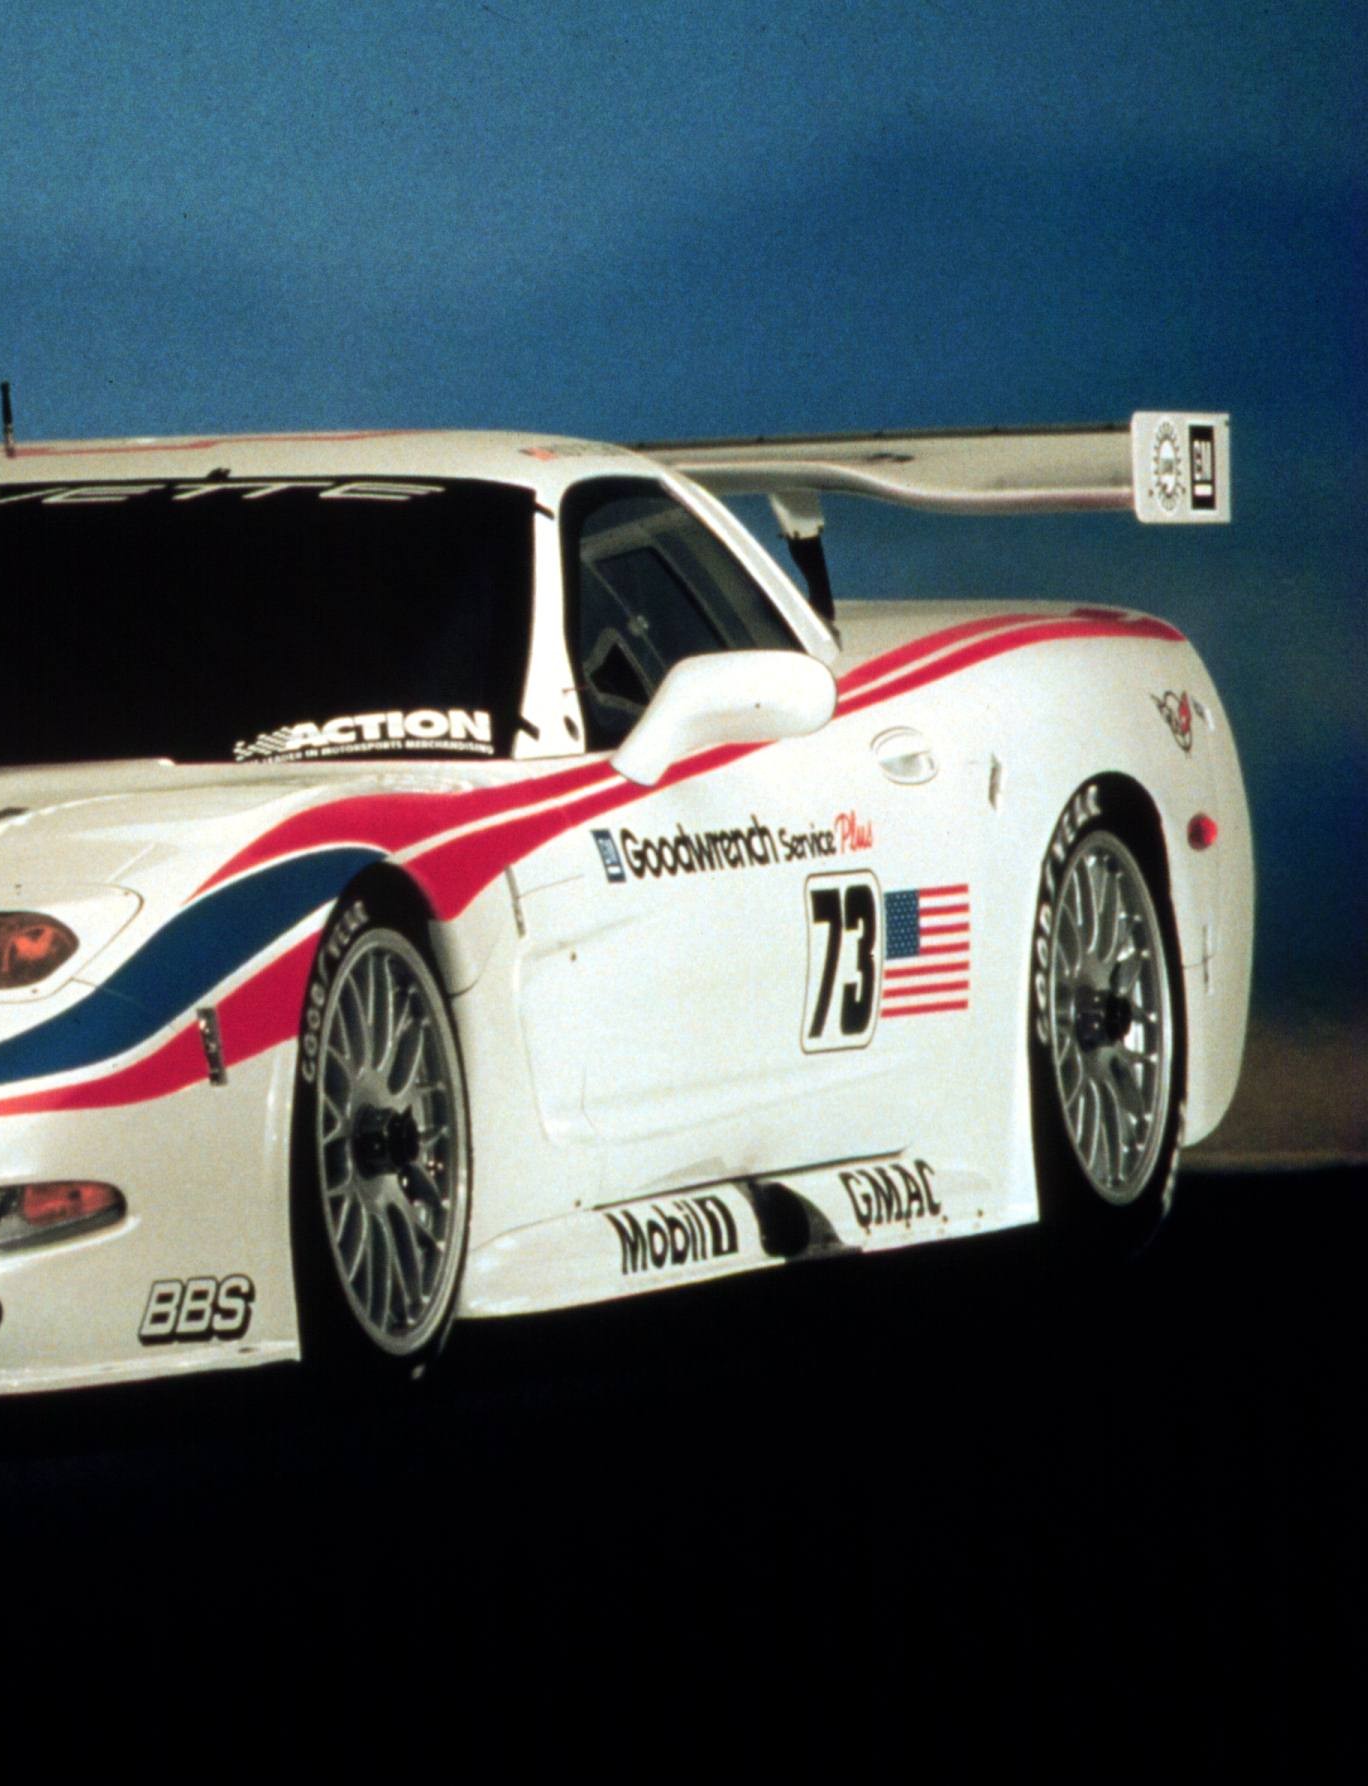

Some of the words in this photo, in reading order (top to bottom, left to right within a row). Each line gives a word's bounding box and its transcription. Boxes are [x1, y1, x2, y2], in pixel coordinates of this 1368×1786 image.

[284, 709, 493, 750] ACTION
[619, 814, 779, 879] Goodwrench
[778, 824, 836, 862] Service
[835, 810, 873, 854] Plus
[804, 884, 877, 1039] 73
[837, 1158, 942, 1228] GMAC
[137, 1272, 256, 1346] BBS
